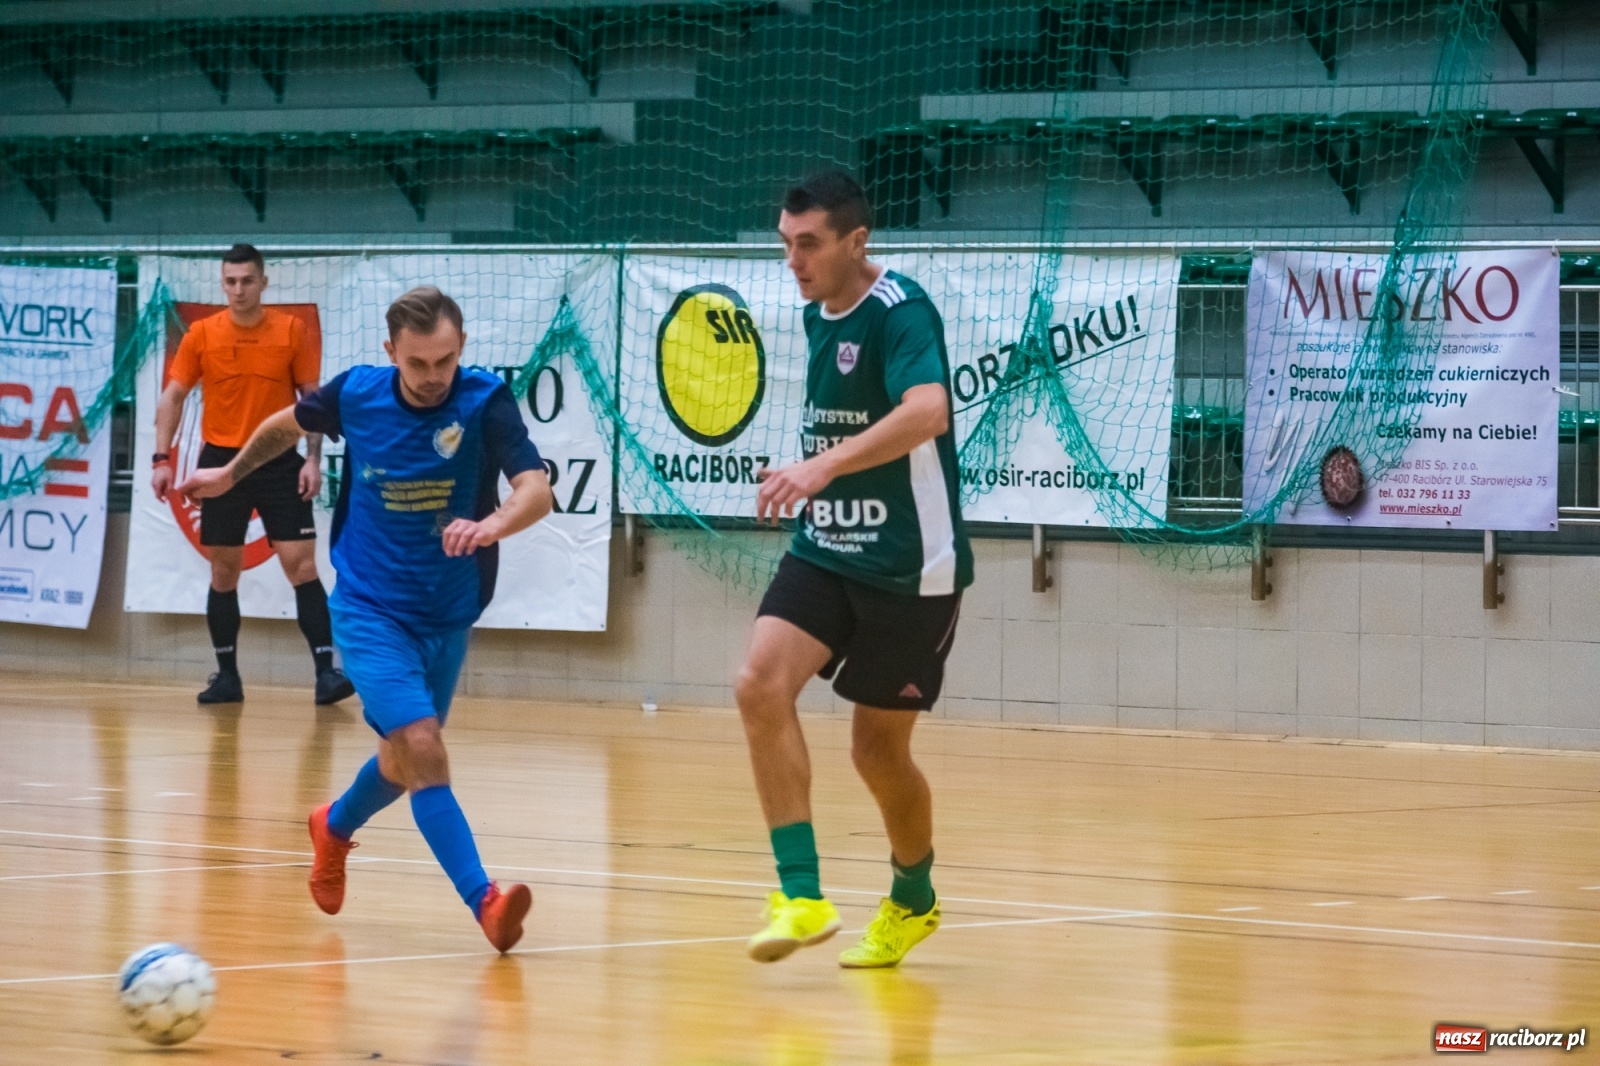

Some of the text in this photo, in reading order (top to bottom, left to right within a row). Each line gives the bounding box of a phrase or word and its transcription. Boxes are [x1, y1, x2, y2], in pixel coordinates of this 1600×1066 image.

[1283, 265, 1520, 324] MIESZKO
[1296, 341, 1351, 355] poszukuje
[1441, 341, 1503, 355] stanowiska:
[1438, 365, 1550, 384] cukierniczych
[1370, 388, 1467, 408] produkcyjny
[1377, 423, 1537, 443] Czekamy na Ciebie!
[653, 449, 770, 485] RACIBÓRZ
[1415, 459, 1431, 470] BIS
[1434, 460, 1449, 471] Sp.
[1452, 462, 1459, 471] z
[1461, 461, 1478, 471] o.o.
[1378, 473, 1409, 485] 47-400
[1412, 474, 1451, 485] Racibórz
[1470, 475, 1533, 488] Starowiejska
[1535, 476, 1548, 487] 75
[1378, 488, 1471, 500] tel. 032 796 11 33
[812, 499, 888, 527] BUD
[1379, 503, 1462, 515] www.mieszko.pl
